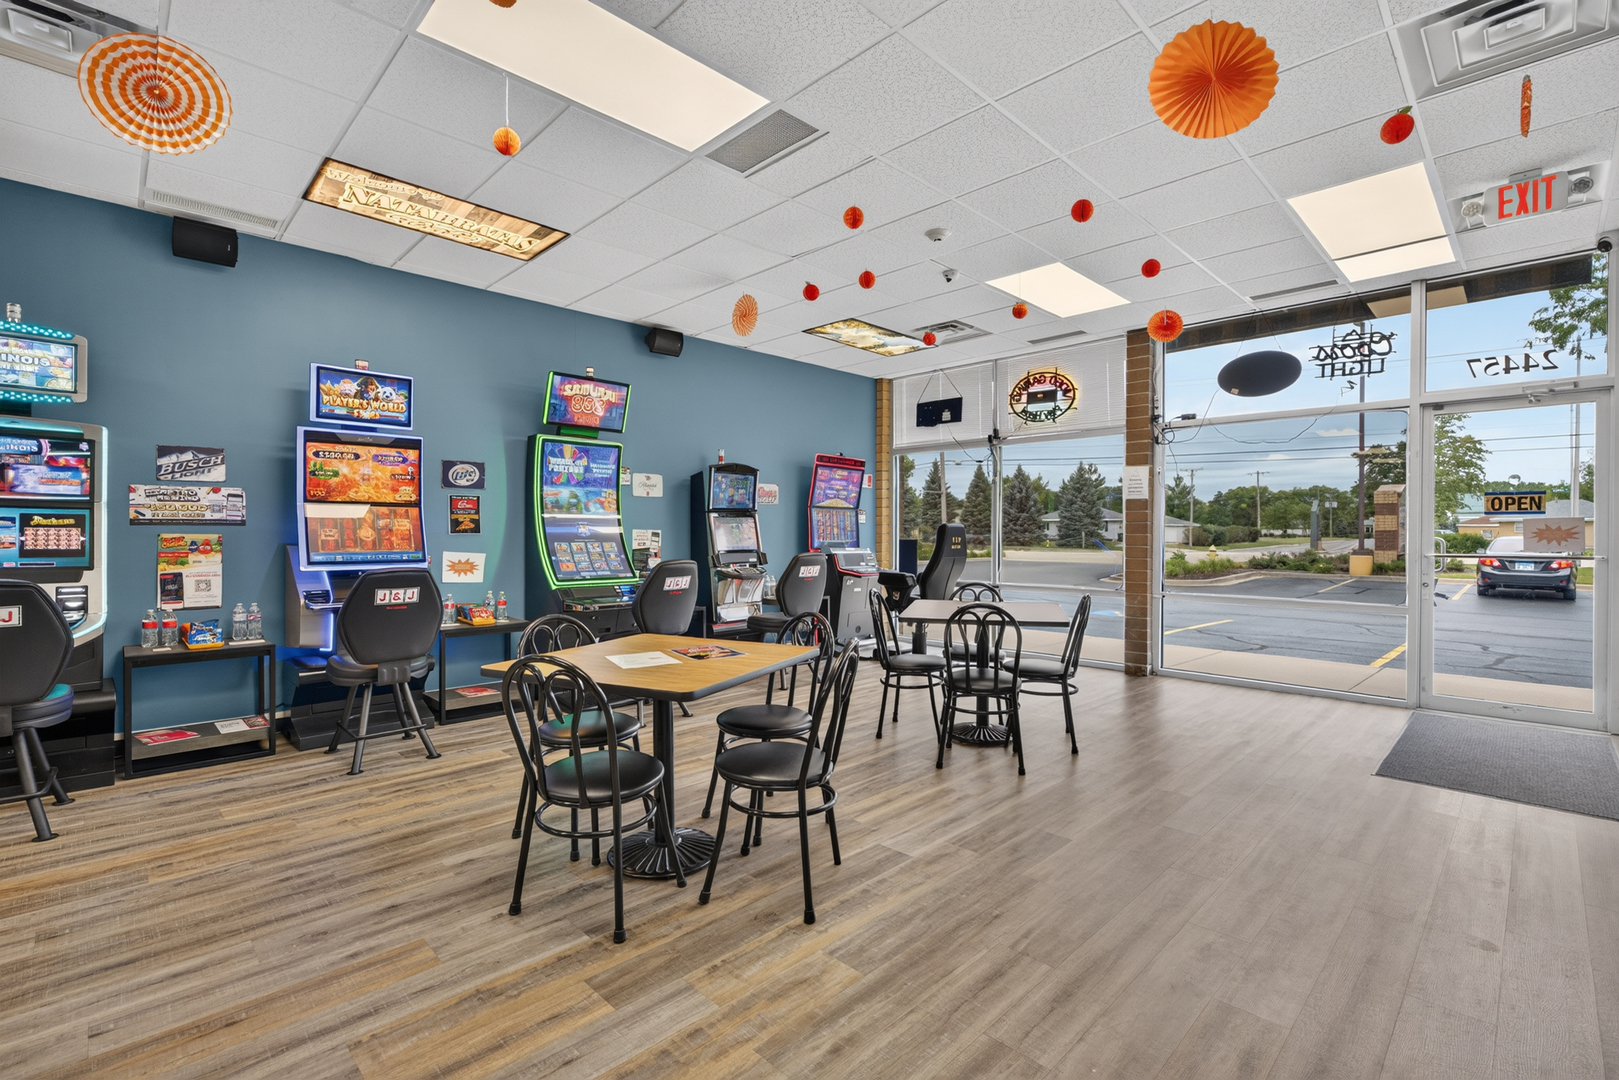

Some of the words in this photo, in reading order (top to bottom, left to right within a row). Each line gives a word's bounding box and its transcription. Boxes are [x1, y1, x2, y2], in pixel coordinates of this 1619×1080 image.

[1498, 174, 1557, 220] EXIT
[0, 353, 51, 367] INOIS
[158, 455, 224, 476] BUSCH
[1490, 495, 1542, 511] OPEN
